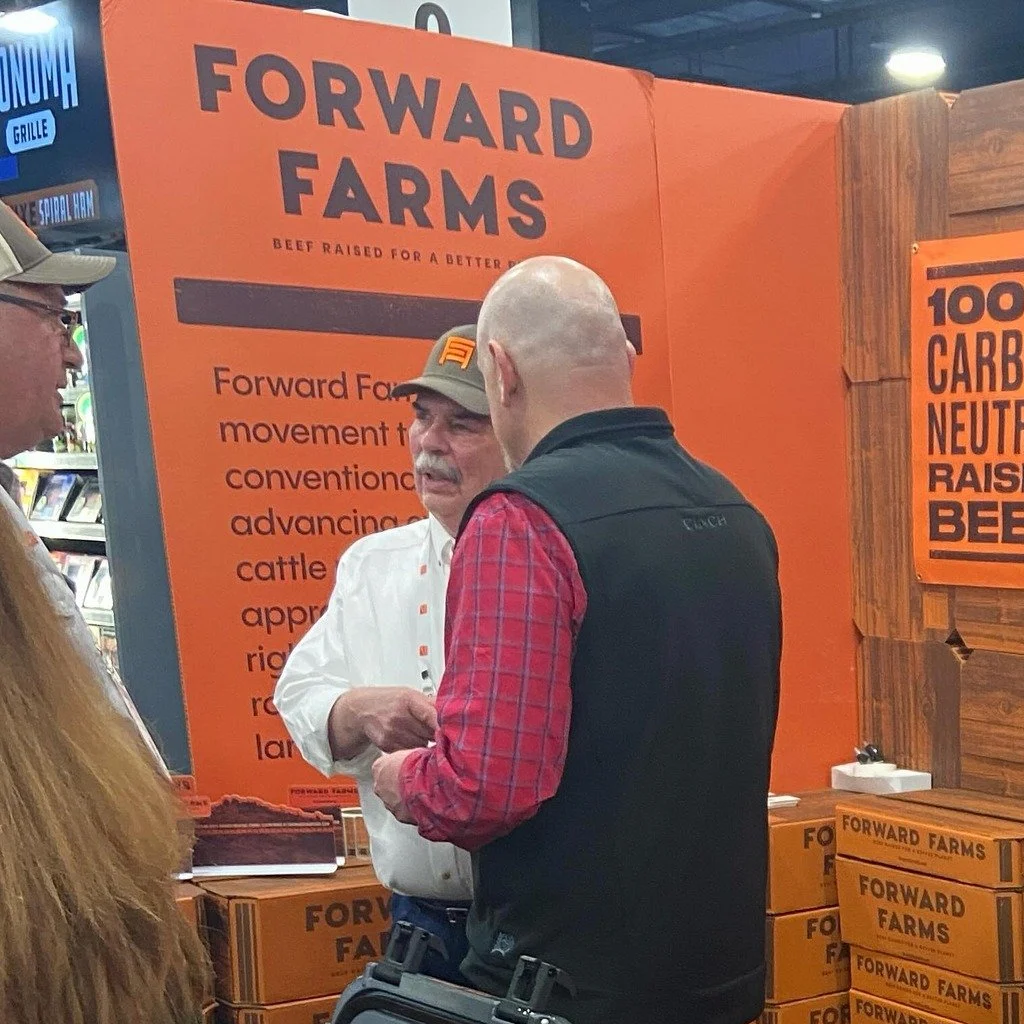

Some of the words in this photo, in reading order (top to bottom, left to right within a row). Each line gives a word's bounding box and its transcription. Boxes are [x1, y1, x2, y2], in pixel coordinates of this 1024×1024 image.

[193, 44, 593, 160] FORWARD
[13, 119, 48, 145] GRILLE
[38, 193, 72, 226] SPIRAL
[73, 189, 95, 219] HAM
[278, 149, 547, 240] FARMS
[273, 238, 314, 253] BEEF
[322, 242, 383, 259] RAISED
[391, 249, 421, 262] FOR
[430, 252, 438, 264] A
[446, 254, 501, 270] BETTER
[213, 366, 348, 400] Forward
[219, 420, 390, 447] movement
[236, 552, 327, 582] cattle
[241, 604, 330, 635] appr
[247, 643, 294, 679] rig
[842, 814, 920, 846] FORWARD
[928, 832, 986, 861] FARMS
[859, 874, 966, 918] FORWARD
[877, 907, 950, 944] FARMS
[856, 954, 930, 991] FORWARD
[938, 978, 992, 1010] FARMS
